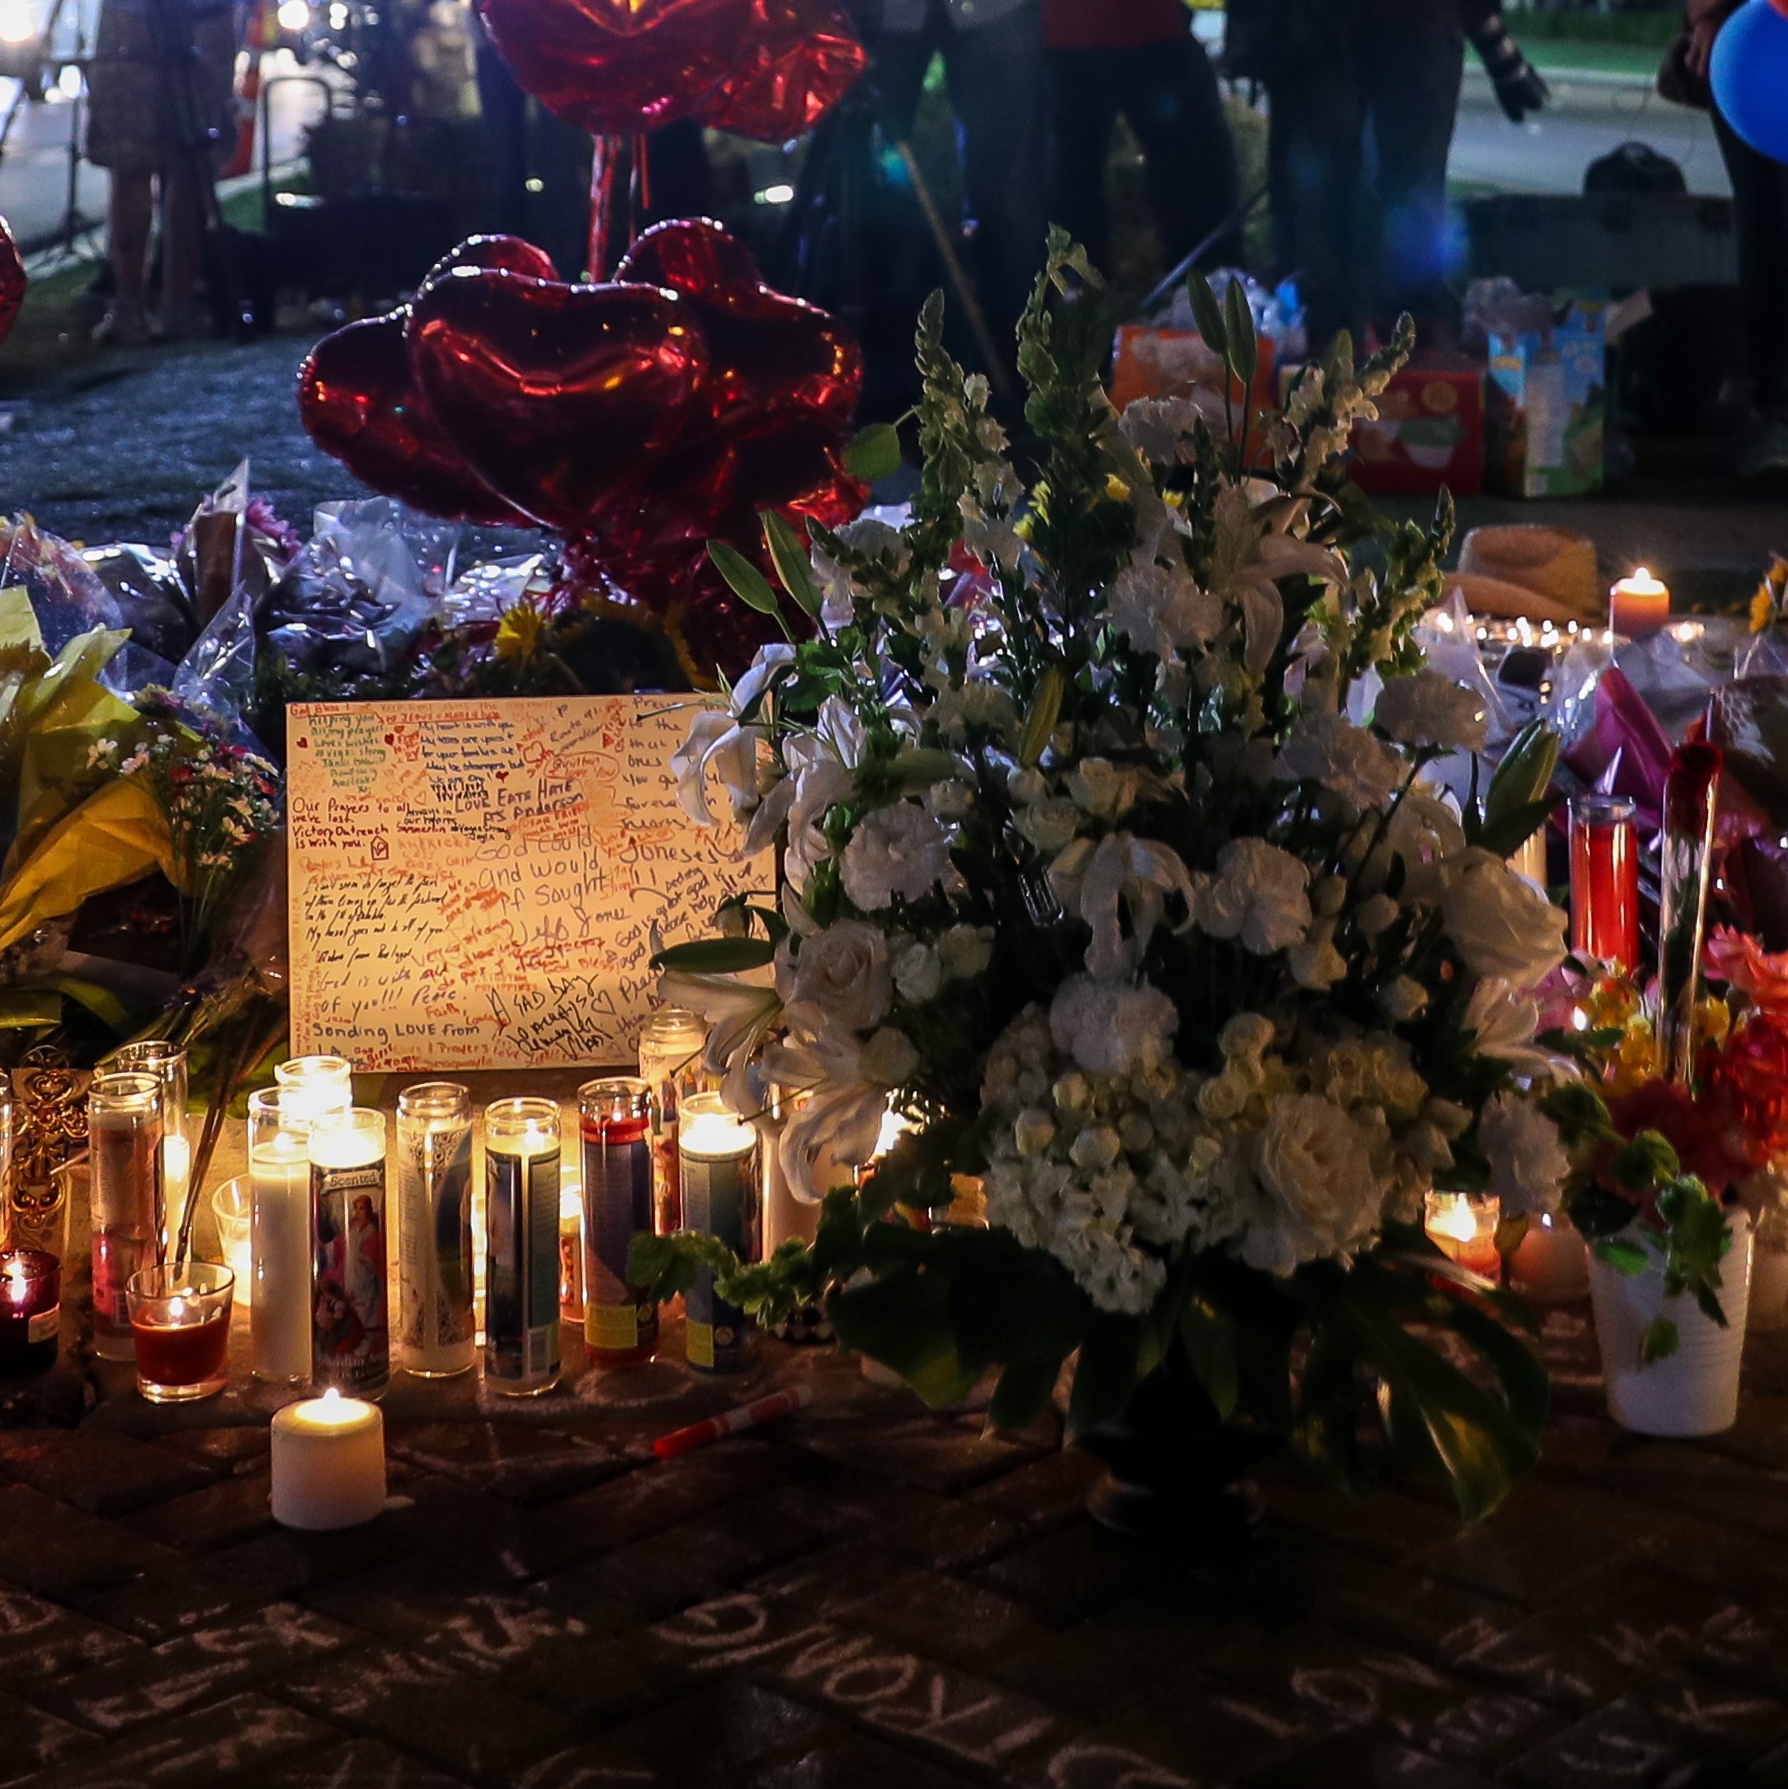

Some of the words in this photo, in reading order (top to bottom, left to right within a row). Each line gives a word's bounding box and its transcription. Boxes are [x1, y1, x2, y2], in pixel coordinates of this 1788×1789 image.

[292, 797, 319, 813] Our
[328, 797, 369, 815] Prayers
[377, 803, 389, 814] to
[295, 839, 305, 850] is
[475, 835, 527, 862] God
[478, 861, 522, 889] and
[530, 846, 598, 878] would
[321, 996, 342, 1014] of
[395, 1023, 436, 1037] LOVE
[442, 1023, 480, 1037] from
[330, 1171, 376, 1188] Scented
